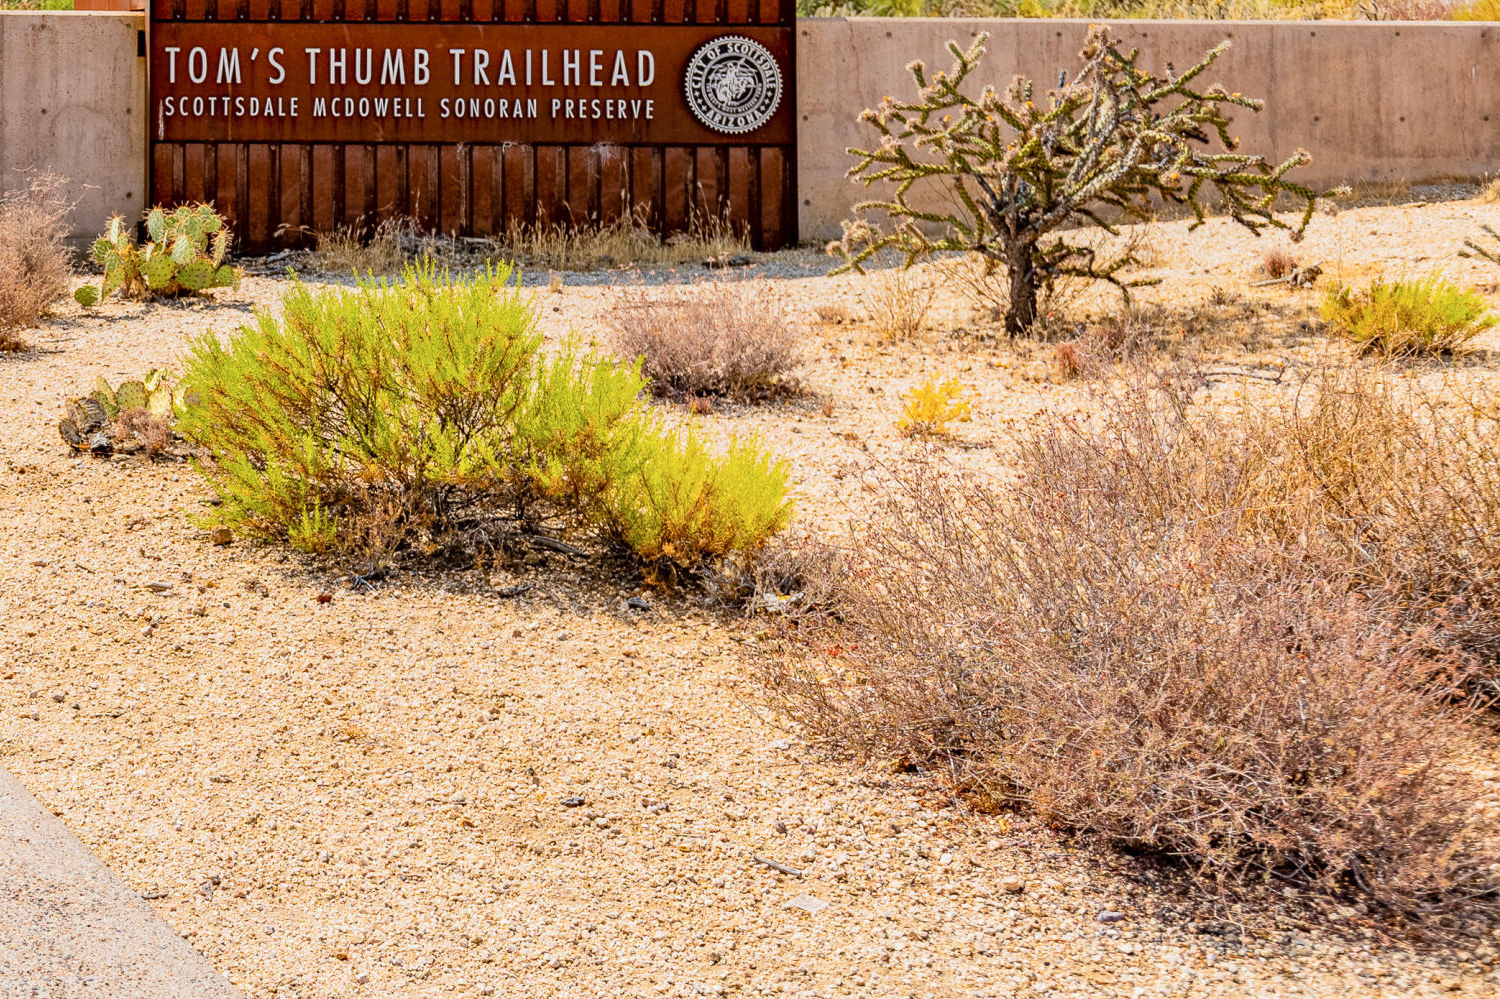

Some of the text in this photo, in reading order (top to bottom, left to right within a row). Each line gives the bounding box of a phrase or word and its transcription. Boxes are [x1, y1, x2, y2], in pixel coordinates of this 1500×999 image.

[164, 46, 656, 87] TOM'S THUMB TRAILHEAD
[692, 43, 776, 89] CITY OF SCOTTSDALE
[164, 96, 655, 120] SCOTTSDALE MCDOWELL SONORAN PRESERVE
[706, 110, 762, 127] ARIZONA
